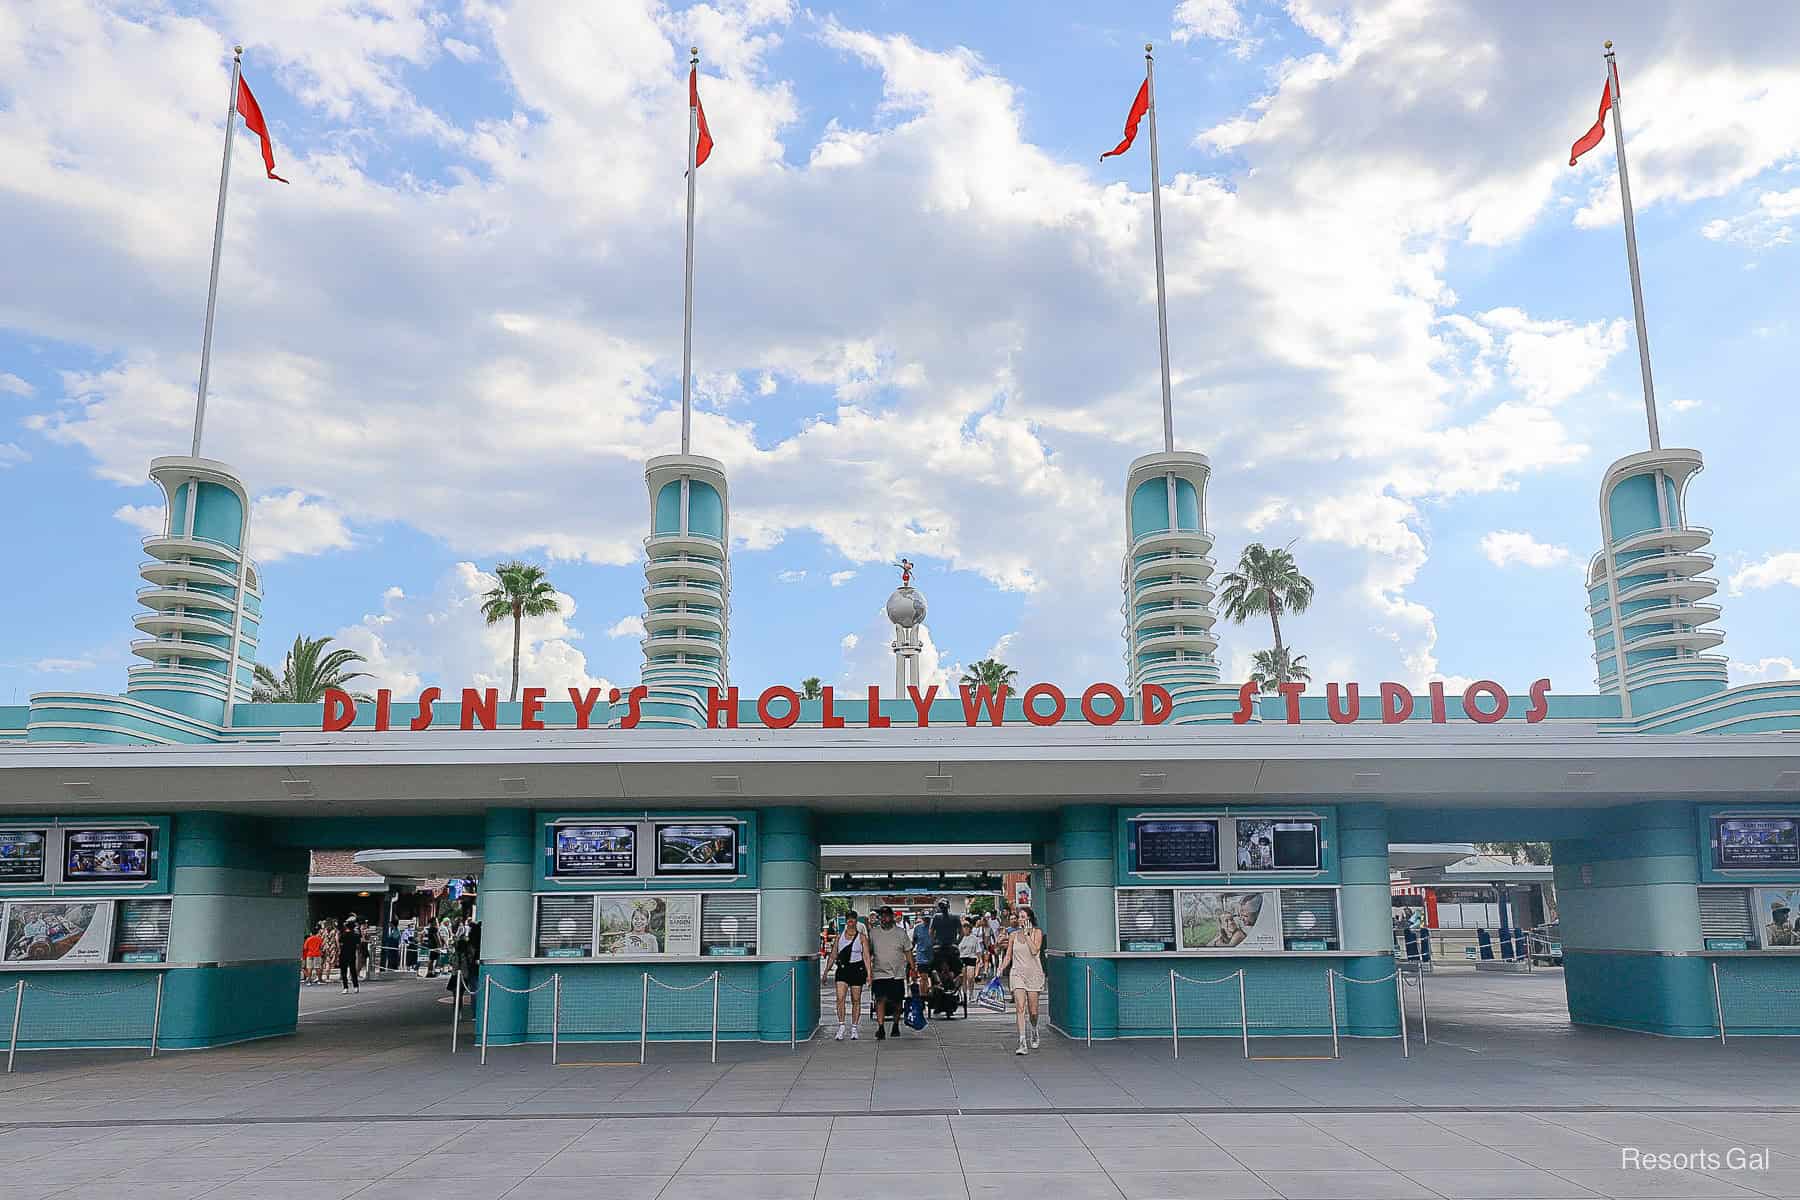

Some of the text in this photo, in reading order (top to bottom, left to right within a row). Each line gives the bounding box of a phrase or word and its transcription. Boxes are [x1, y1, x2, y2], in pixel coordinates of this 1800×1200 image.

[322, 678, 1552, 732] DISNEY'S HOLLYWOOD STUDIOS
